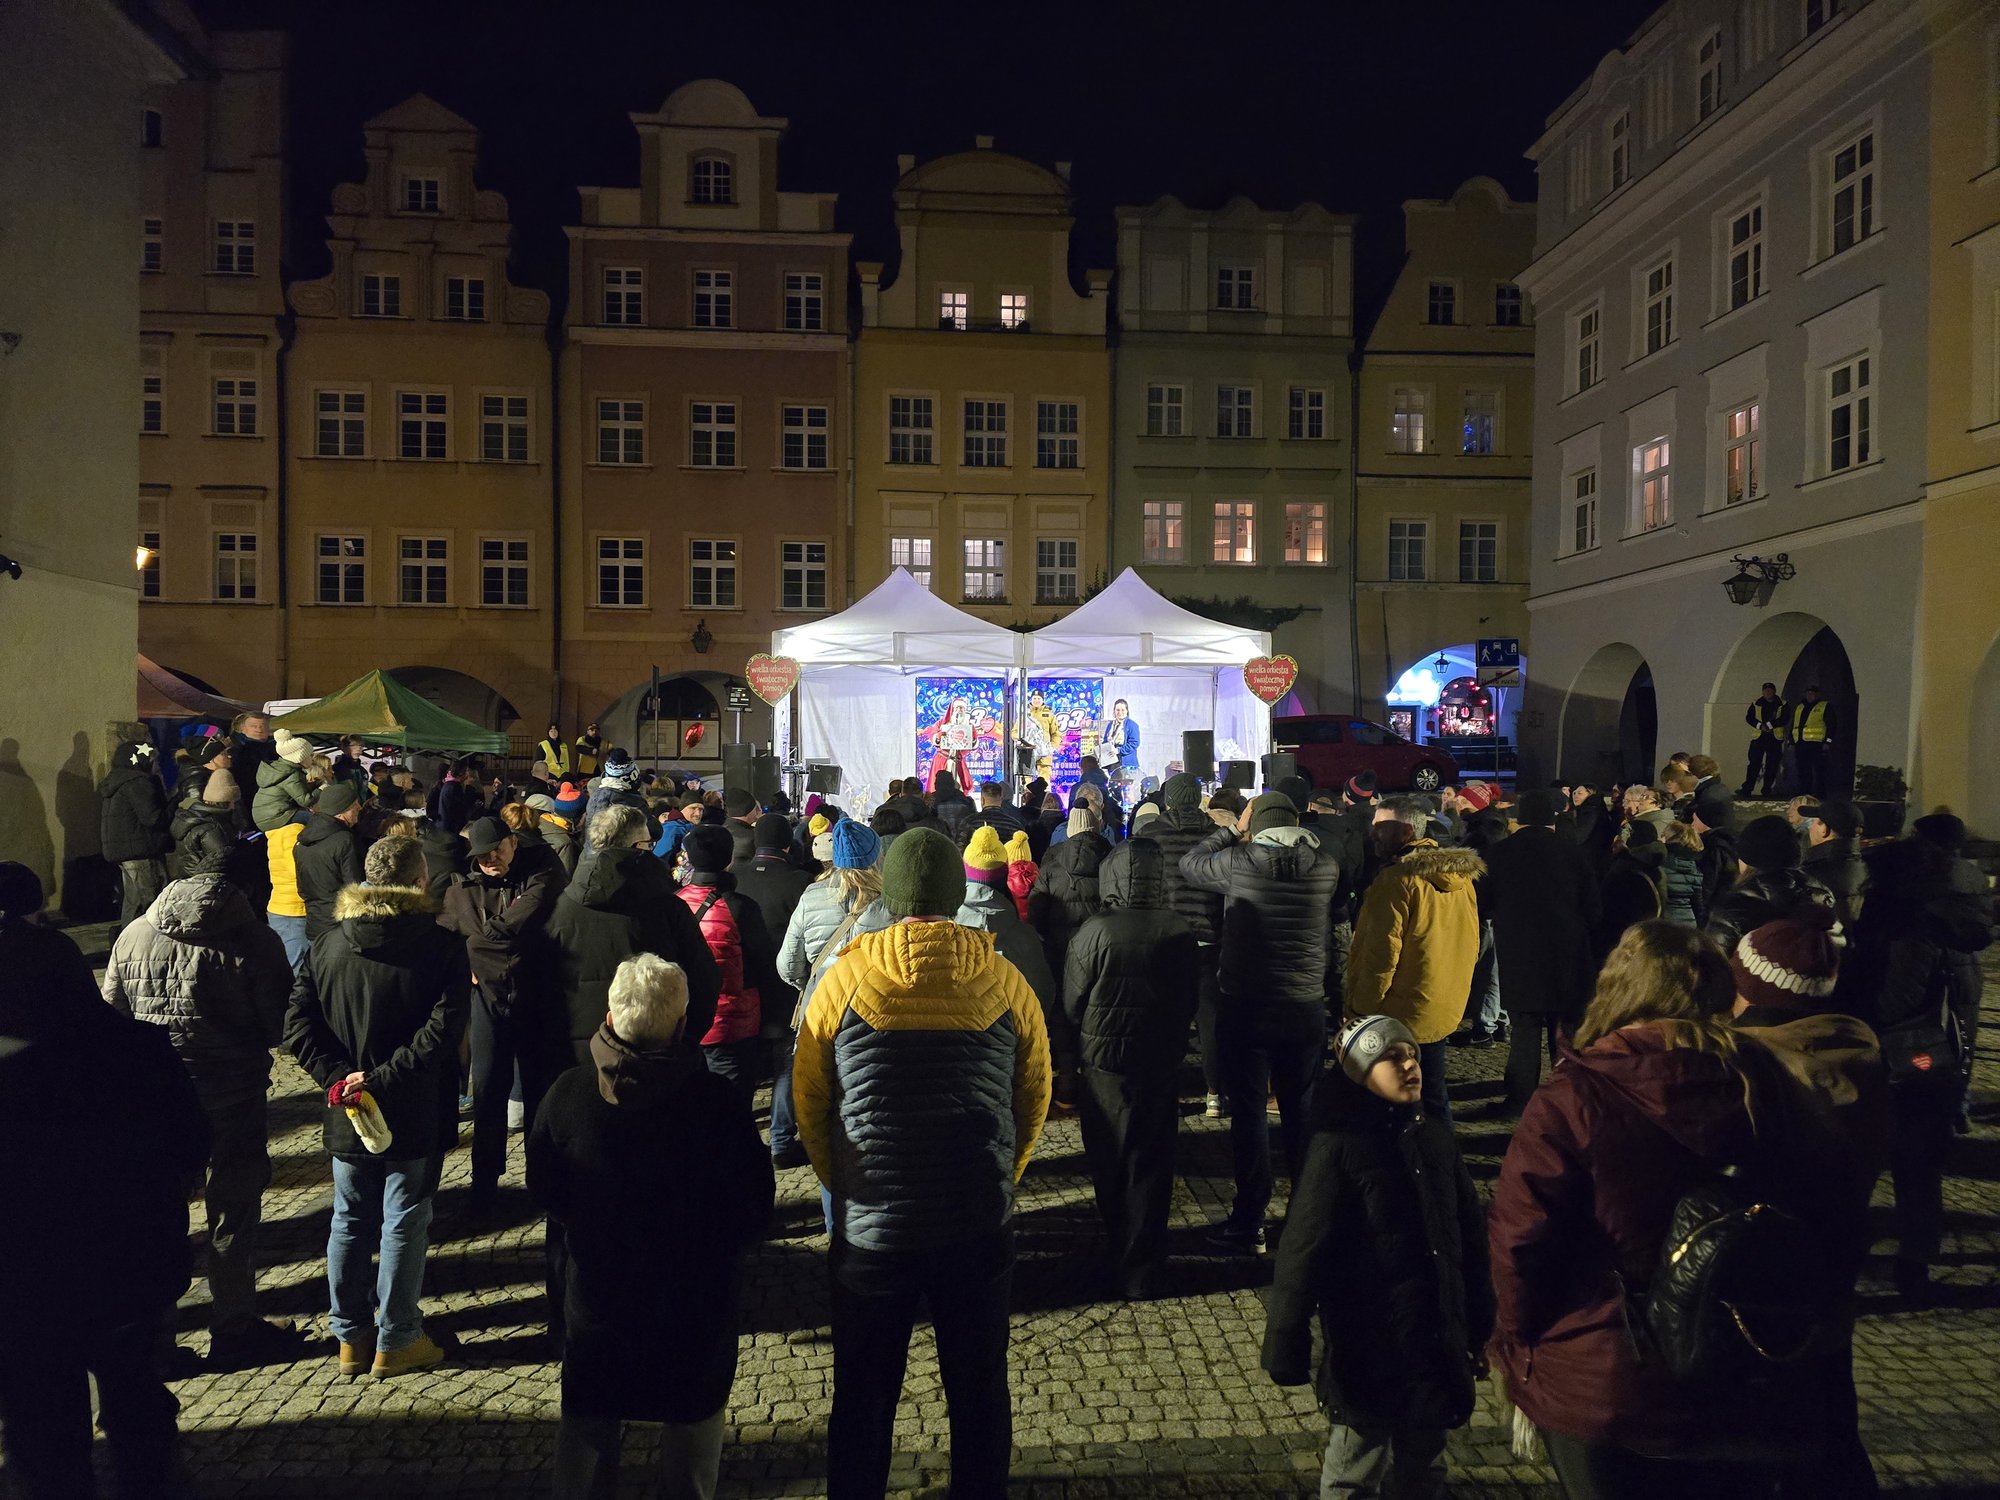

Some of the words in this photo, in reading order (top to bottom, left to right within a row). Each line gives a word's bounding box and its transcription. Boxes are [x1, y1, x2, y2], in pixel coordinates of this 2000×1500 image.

[752, 664, 769, 673] wielka
[1249, 664, 1266, 674] wielka
[1267, 664, 1289, 674] orkiestra
[763, 685, 783, 694] pomocy
[1260, 685, 1280, 695] pomocy
[1055, 708, 1087, 733] 33
